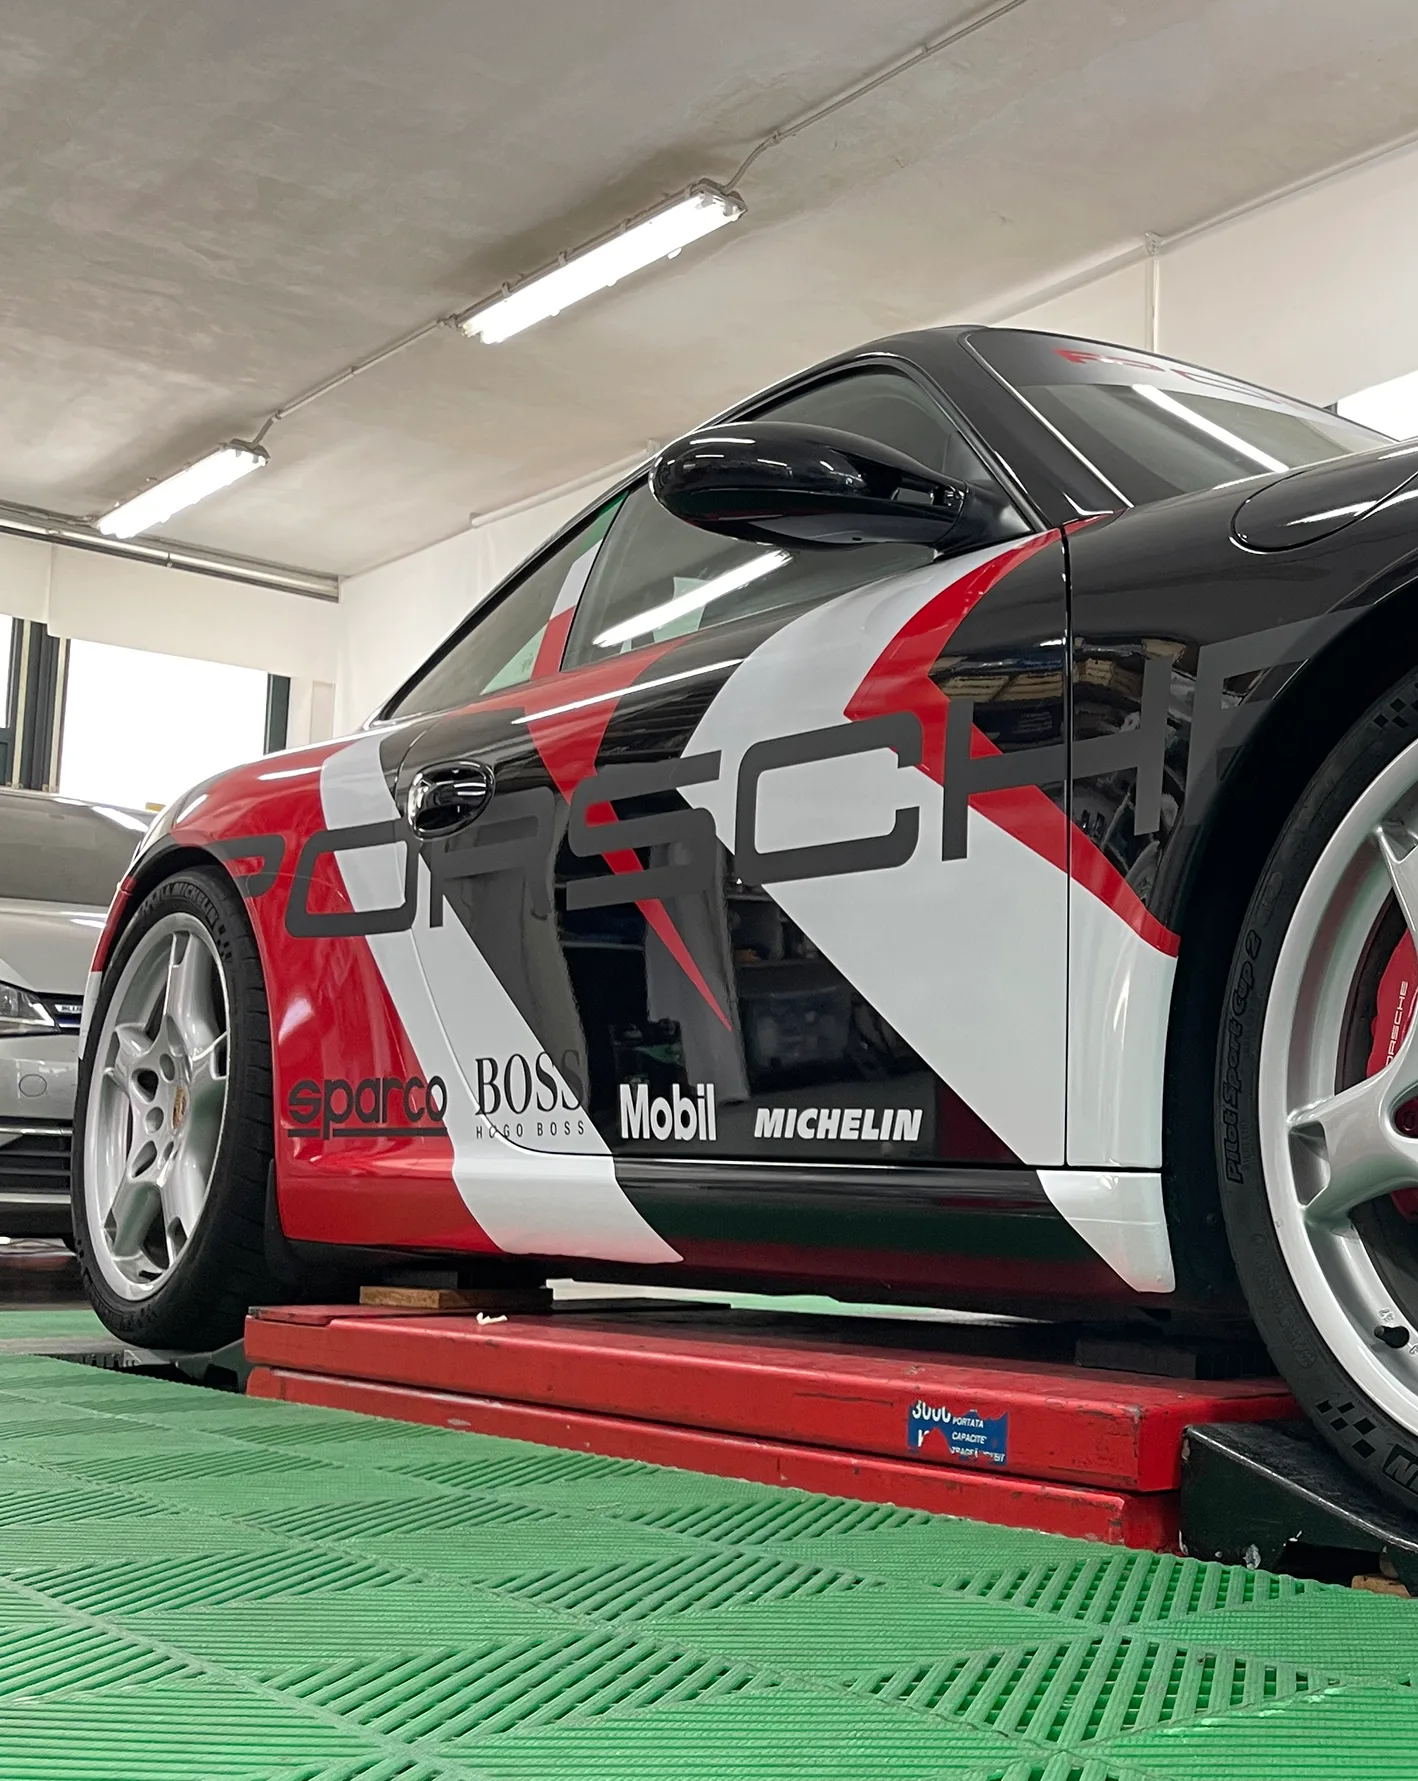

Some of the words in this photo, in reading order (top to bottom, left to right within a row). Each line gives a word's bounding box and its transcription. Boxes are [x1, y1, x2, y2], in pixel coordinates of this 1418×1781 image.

[1245, 929, 1263, 961] 2
[1231, 961, 1255, 1016] Cup
[475, 1049, 586, 1116] BOSS
[1222, 1016, 1244, 1109] Sport
[288, 1075, 448, 1141] sparco
[536, 1120, 585, 1137] BOSS
[619, 1083, 717, 1141] Mobil
[753, 1108, 923, 1142] MICHELIN
[1222, 1107, 1245, 1184] Pilot
[951, 1417, 984, 1429] PORTATA
